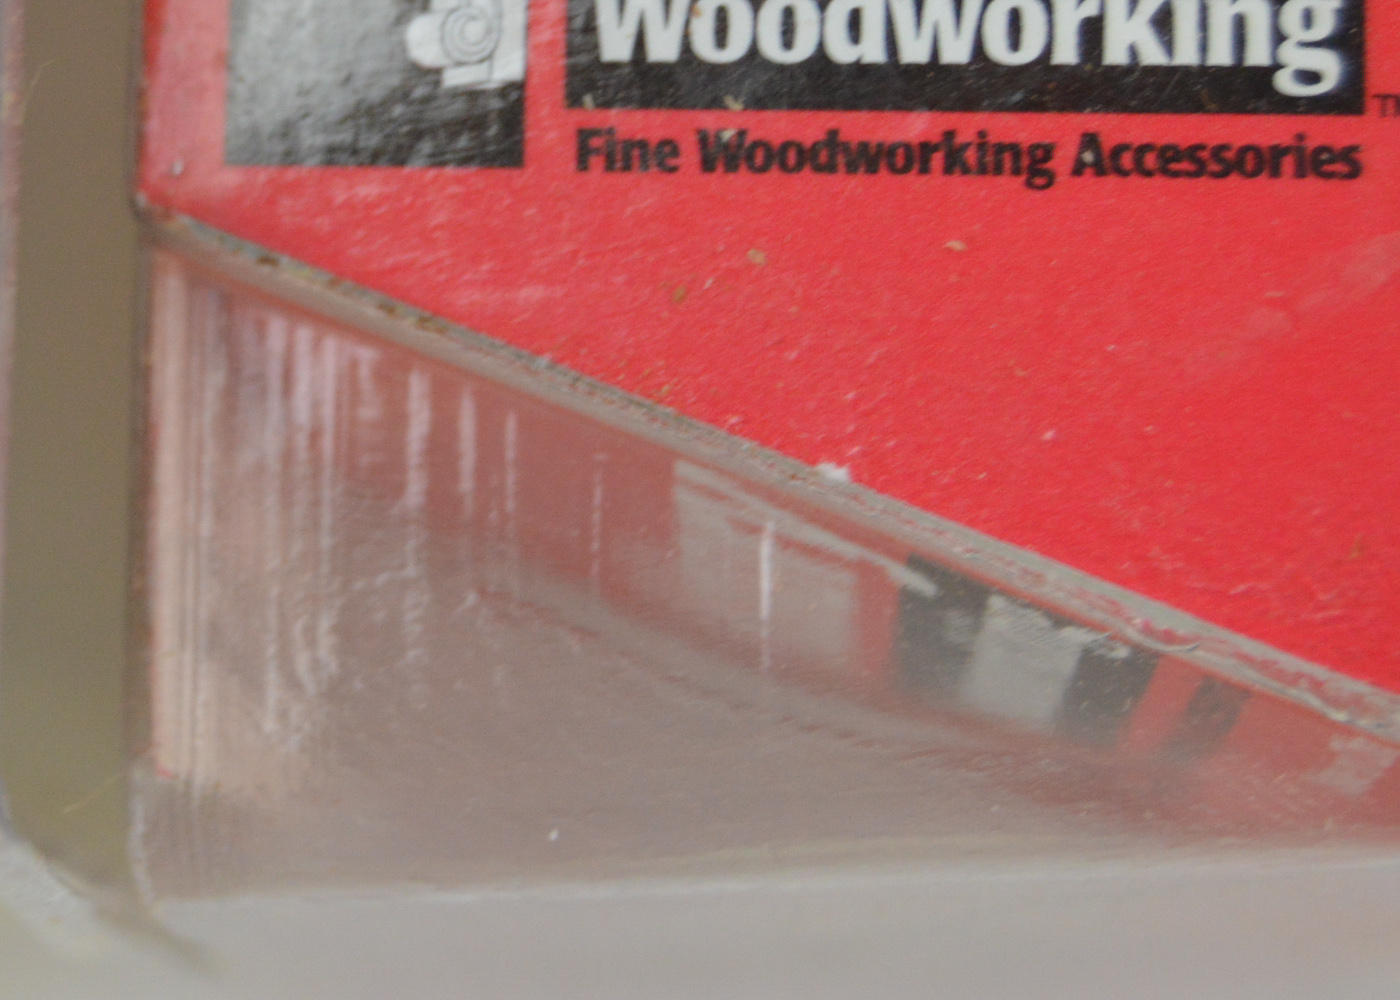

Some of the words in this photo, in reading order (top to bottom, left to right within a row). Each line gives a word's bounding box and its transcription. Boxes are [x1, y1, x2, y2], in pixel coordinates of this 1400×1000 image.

[575, 127, 678, 172] Fine
[696, 128, 1055, 190] Woodworking
[1071, 131, 1363, 181] Accessories
